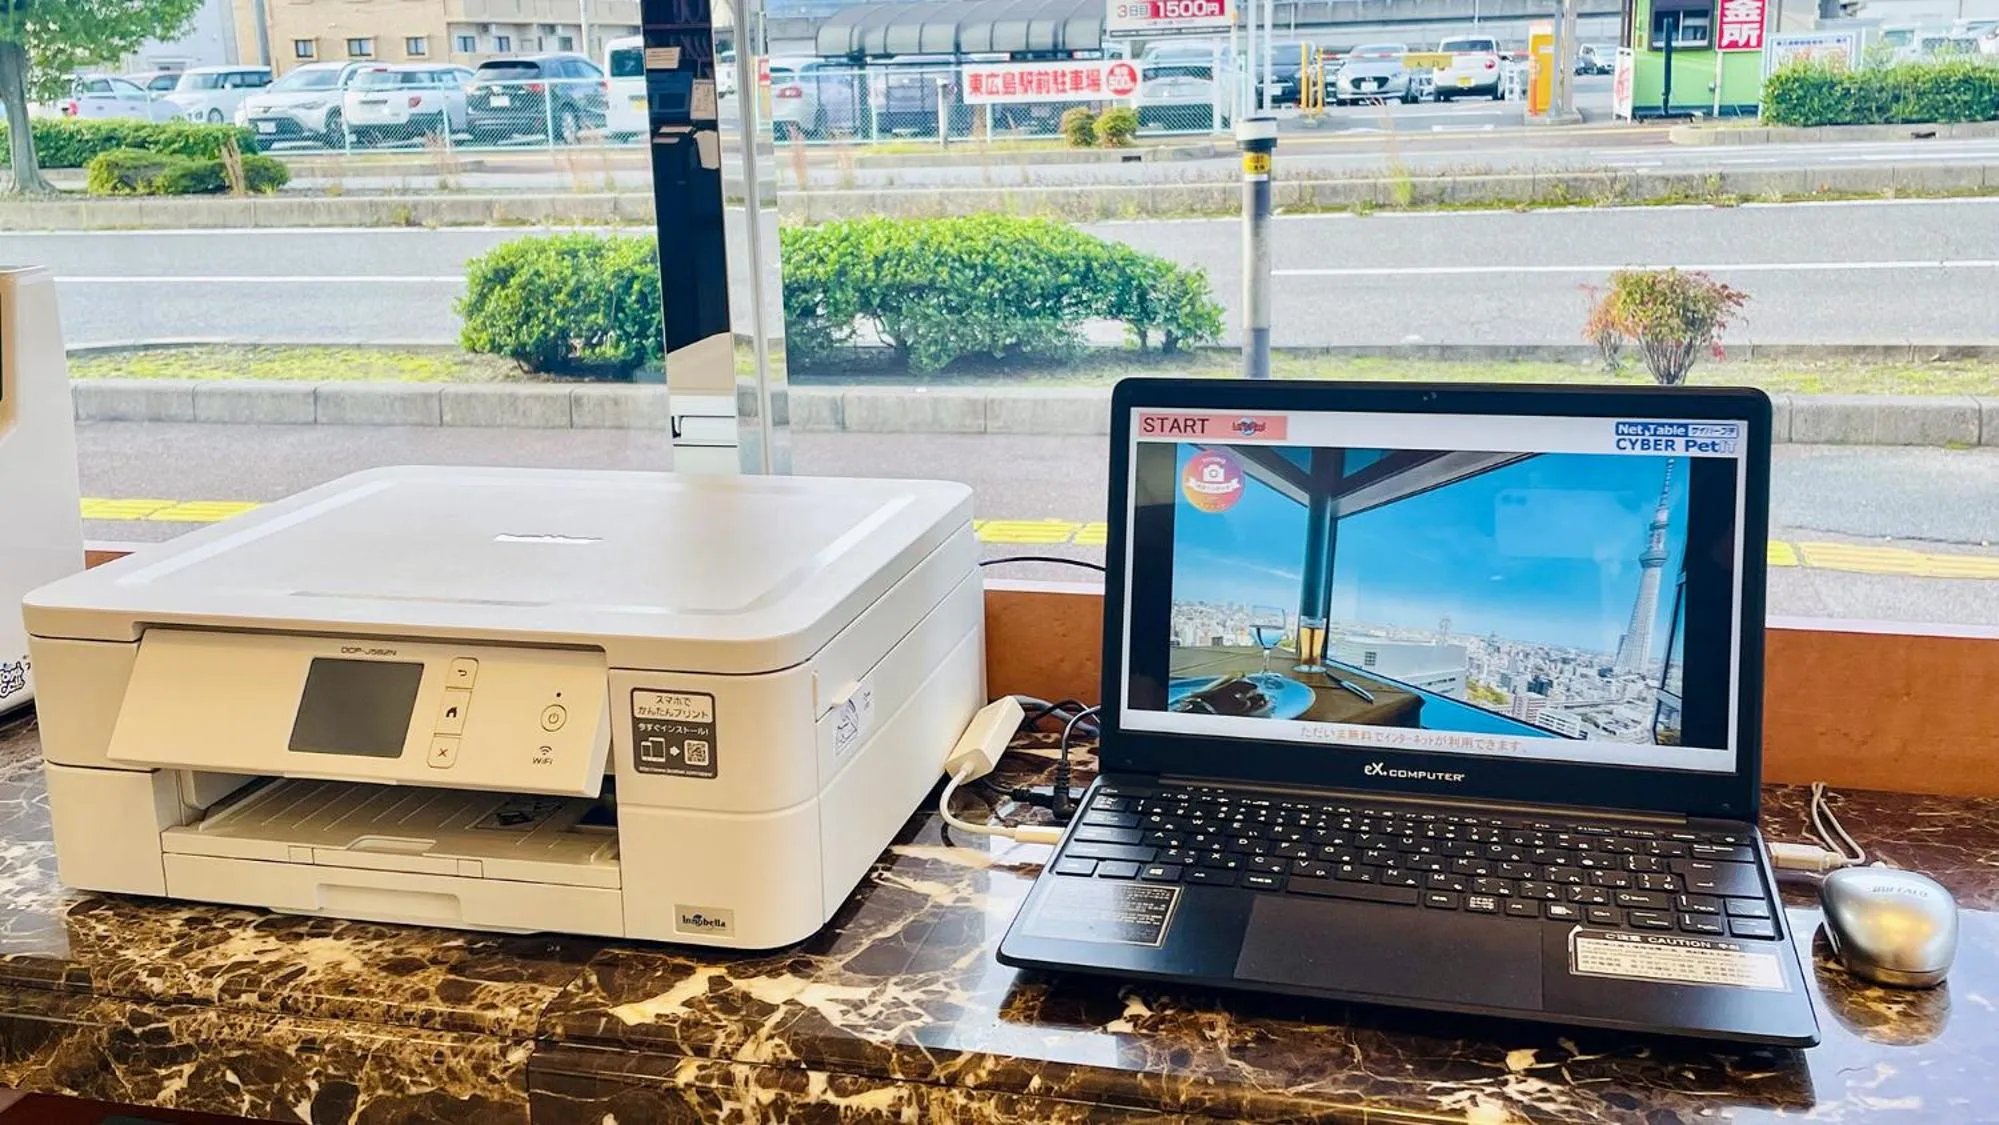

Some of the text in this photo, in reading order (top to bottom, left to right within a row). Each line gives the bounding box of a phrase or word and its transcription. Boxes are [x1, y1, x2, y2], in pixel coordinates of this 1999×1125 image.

[968, 69, 1100, 96] 東広島駅前駐車場
[1143, 417, 1209, 434] START
[1616, 438, 1676, 452] CYBER
[655, 695, 692, 706] スマホで
[637, 706, 708, 719] かんたんプリント
[1648, 936, 1711, 948] CAUTION
